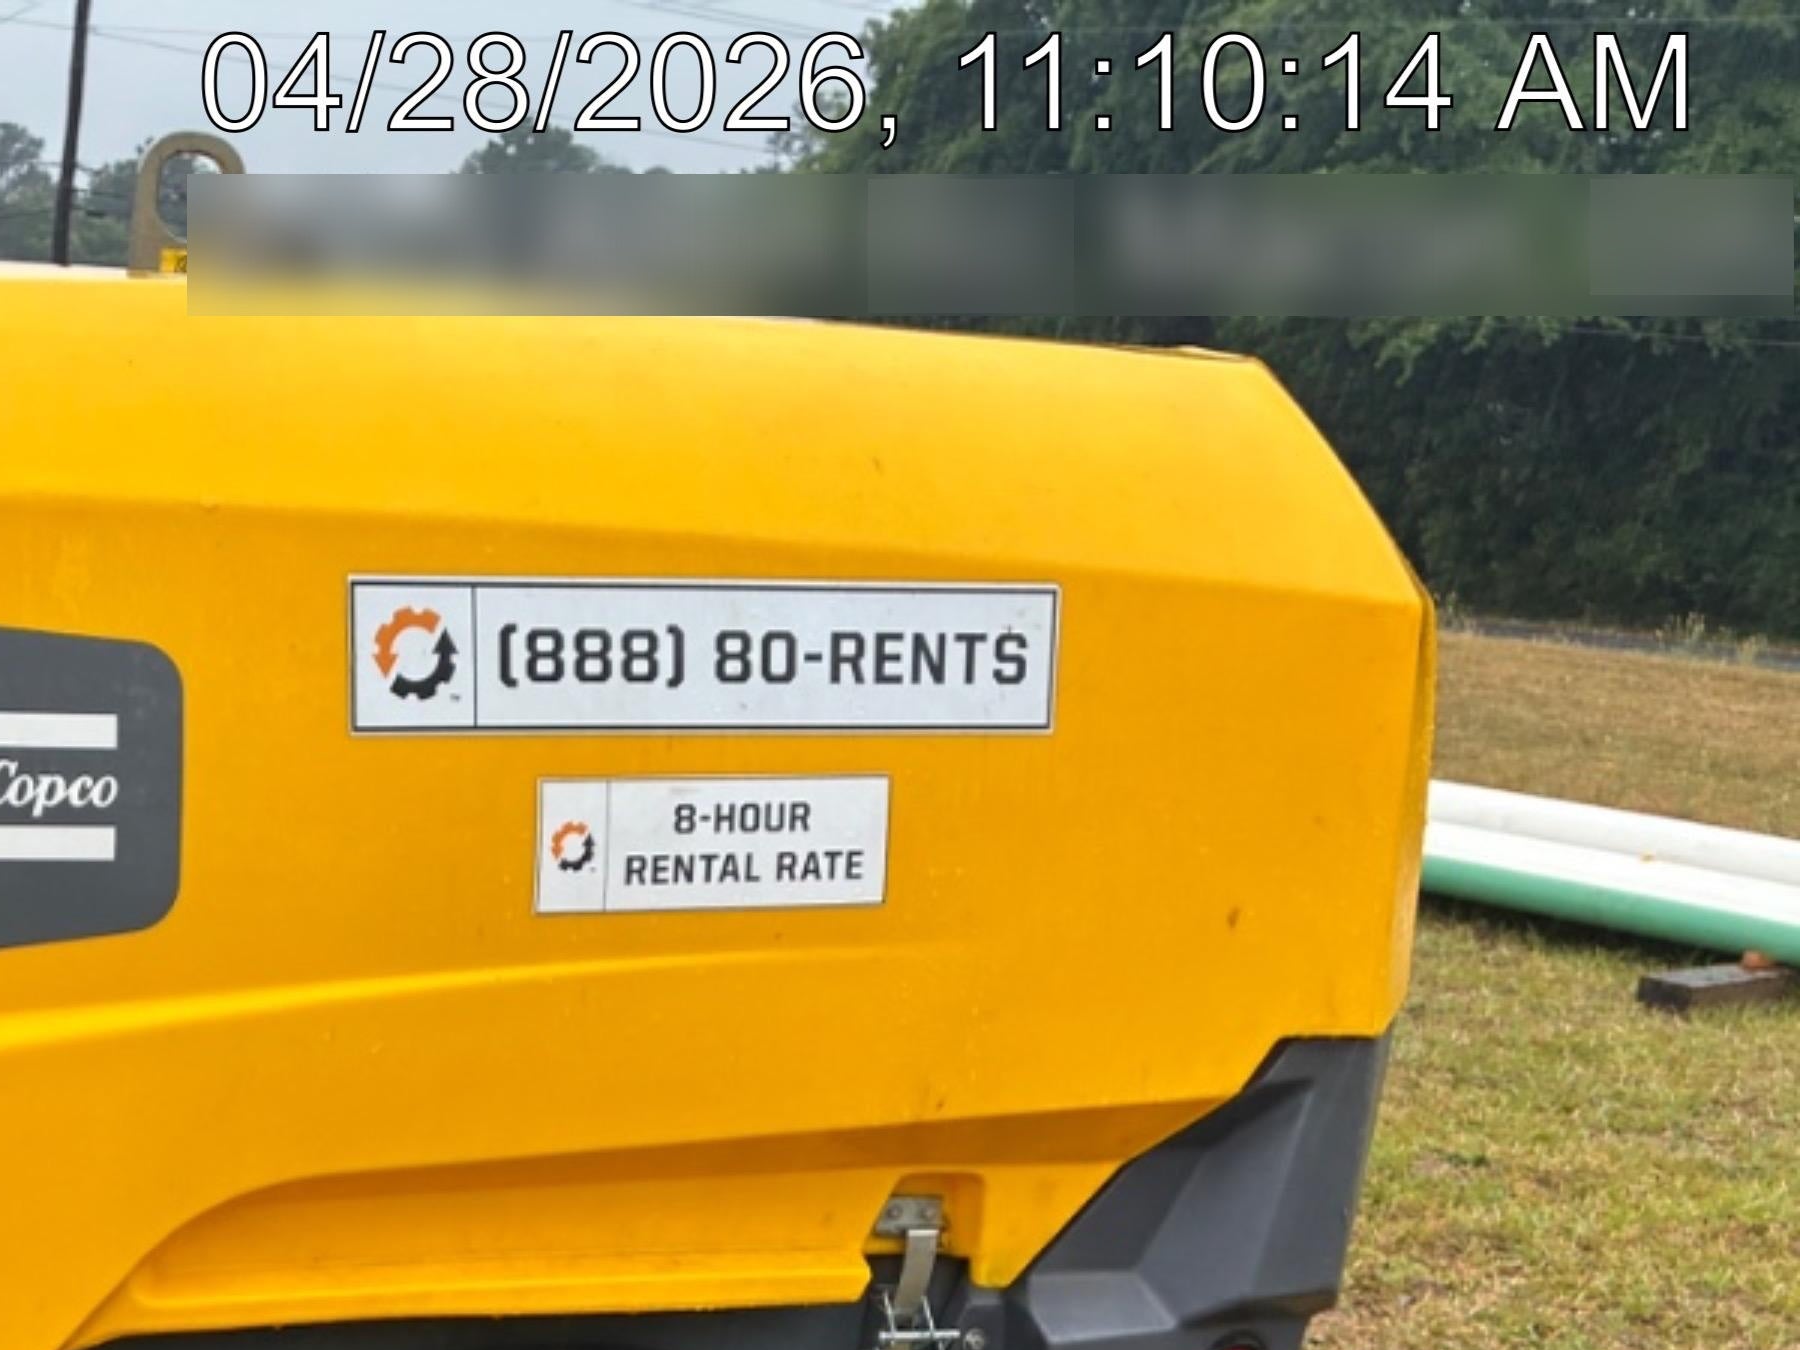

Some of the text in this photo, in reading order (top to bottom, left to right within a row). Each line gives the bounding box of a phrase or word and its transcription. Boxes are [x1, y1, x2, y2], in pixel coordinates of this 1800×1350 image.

[499, 623, 1029, 690] (888) 80-RENTS
[673, 801, 812, 835] 8-HOUR
[624, 849, 865, 887] RENTAL RATE
